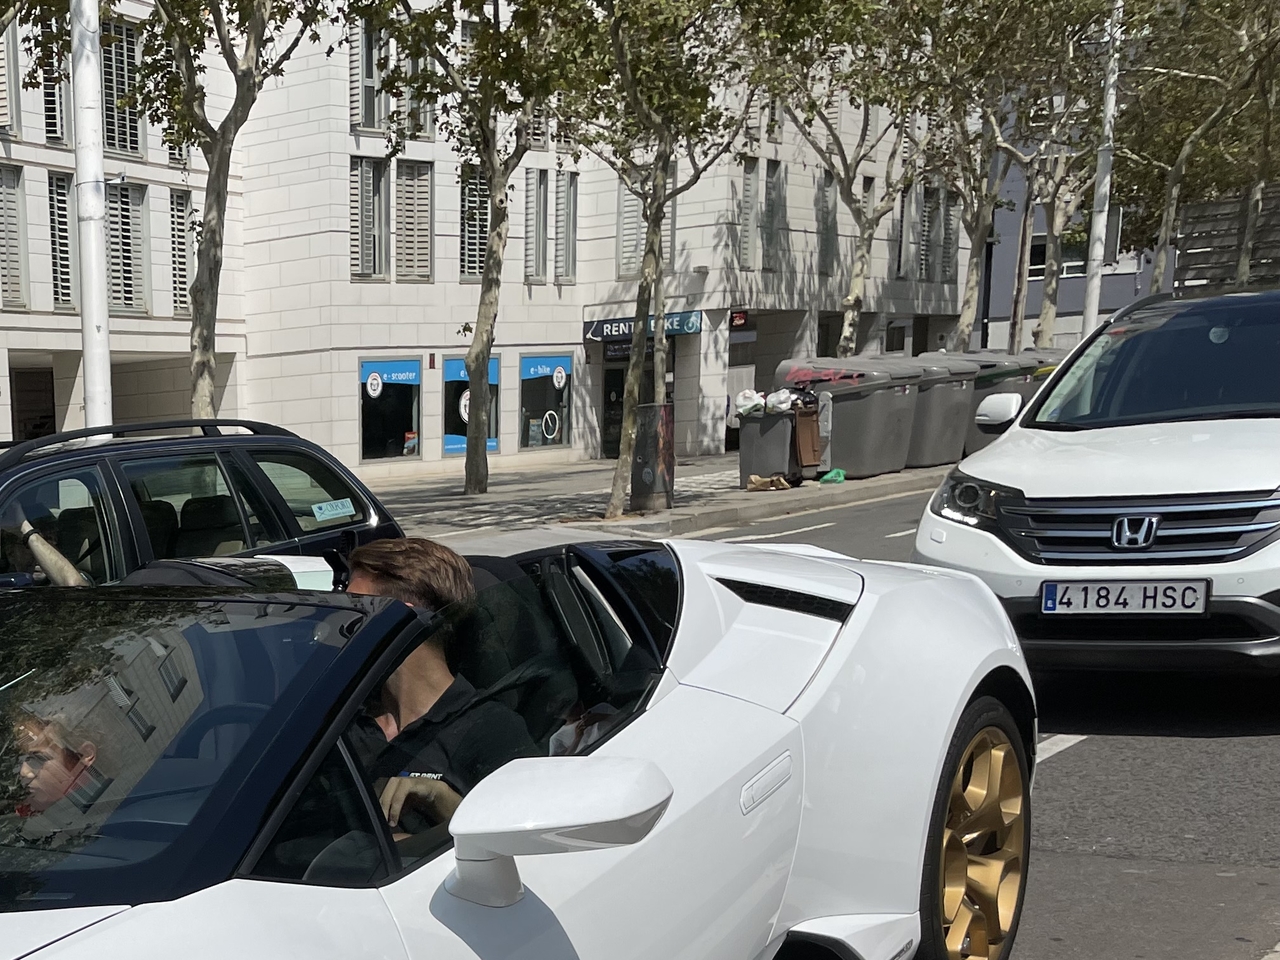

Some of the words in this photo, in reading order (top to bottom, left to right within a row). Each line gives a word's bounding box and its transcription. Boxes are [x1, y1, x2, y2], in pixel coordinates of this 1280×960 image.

[603, 321, 634, 336] RENT
[1058, 585, 1129, 609] 4184
[1141, 585, 1198, 609] HSC
